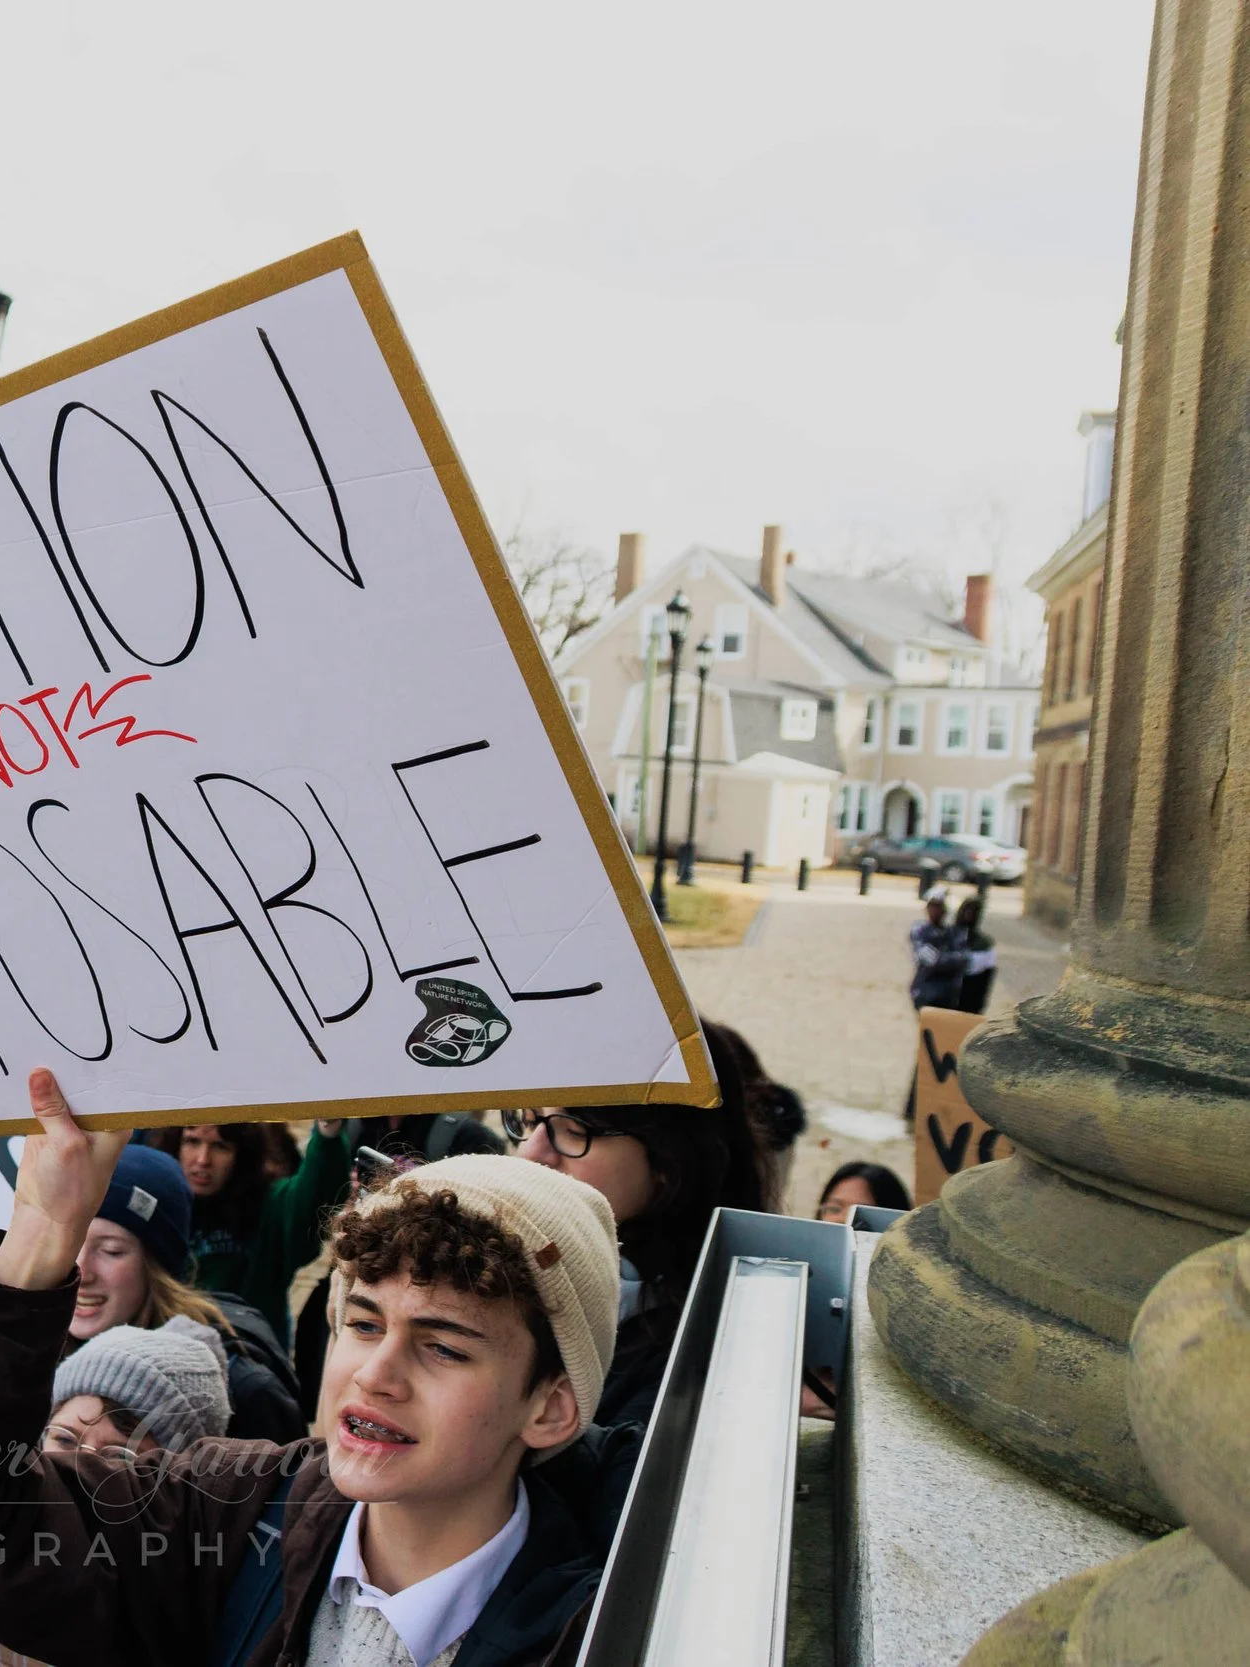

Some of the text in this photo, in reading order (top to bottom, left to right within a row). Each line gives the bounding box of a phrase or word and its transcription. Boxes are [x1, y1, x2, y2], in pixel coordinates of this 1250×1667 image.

[420, 988, 488, 1010] NATURE NETWORK
[428, 982, 479, 999] UNITED SPIRIT
